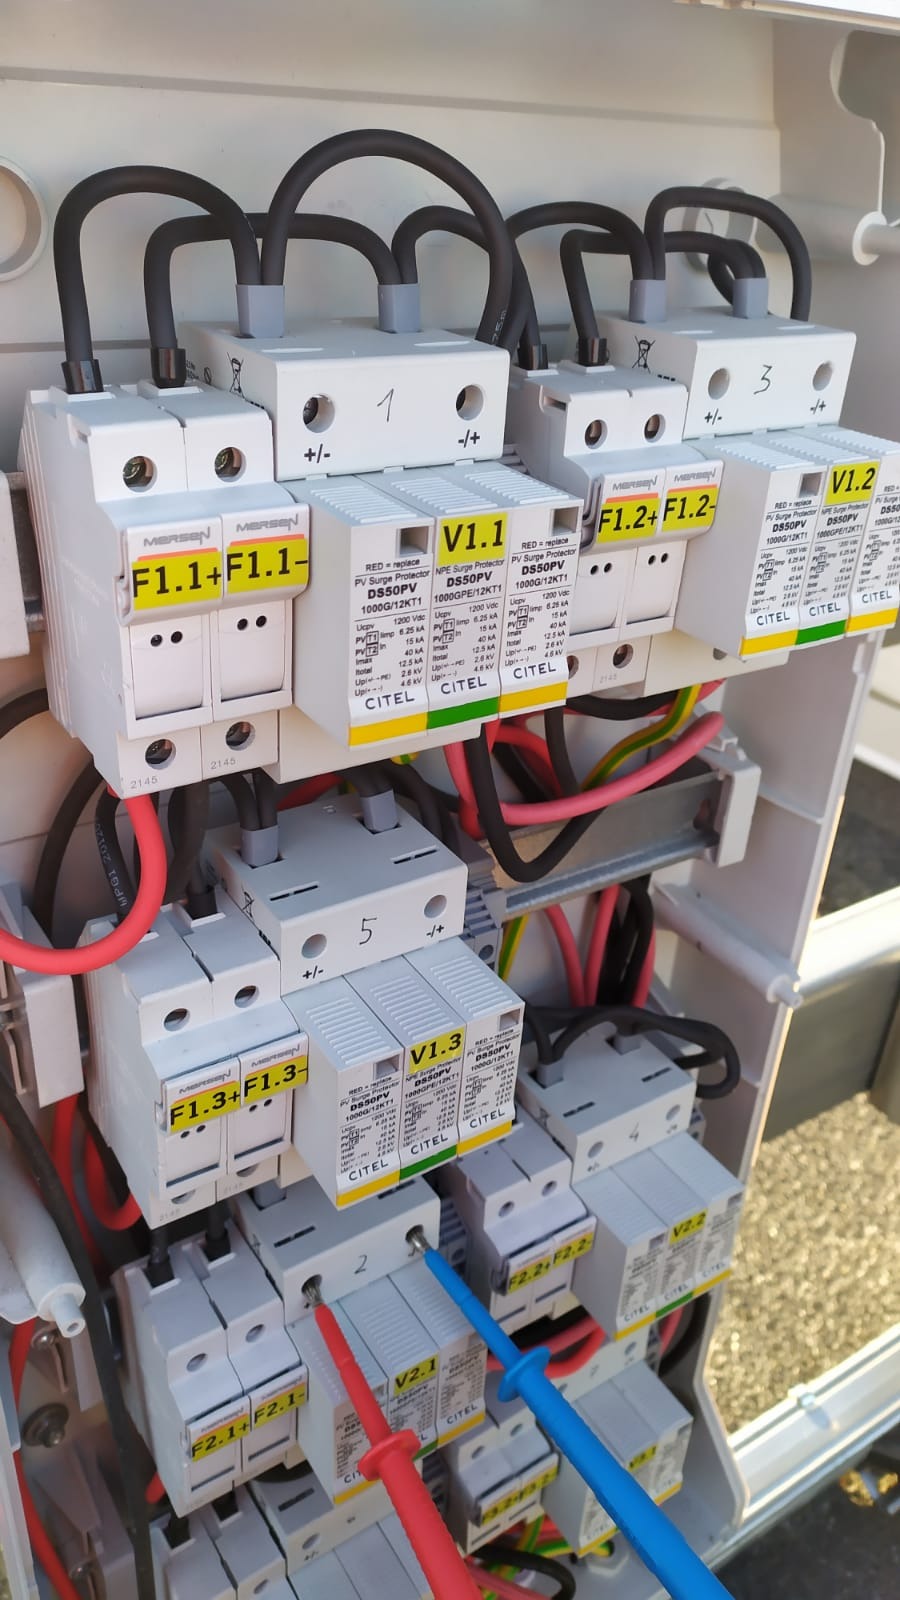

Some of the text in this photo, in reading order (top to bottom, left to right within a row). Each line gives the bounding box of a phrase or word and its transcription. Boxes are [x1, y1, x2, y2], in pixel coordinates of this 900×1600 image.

[753, 364, 773, 395] 3
[377, 388, 394, 423] 1
[832, 467, 876, 494] V1.2
[663, 494, 716, 522] F1.2-
[236, 513, 299, 533] MERSEN
[598, 505, 658, 533] F1.2+
[772, 520, 807, 533] DS50PV
[827, 513, 859, 526] DS50PV
[143, 526, 211, 547] MERSEN
[443, 519, 504, 553] V1.1
[521, 538, 569, 550] RED replace
[766, 532, 808, 545] 1000G/12KT1
[227, 547, 309, 582] F1.1-
[365, 558, 420, 572] RED replace
[511, 548, 577, 564] PV Surge Protector
[453, 563, 473, 574] Surge
[474, 559, 505, 570] Protector
[521, 560, 565, 576] DS50PV
[132, 561, 222, 598] F1.1+
[354, 569, 431, 587] PV Surge Protector
[446, 571, 493, 588] DS50PV
[515, 574, 568, 590] 1000G/12KT1
[367, 582, 418, 599] DS50PV
[434, 584, 502, 603] 1000GPE/12KT1
[861, 590, 892, 604] CITEL
[361, 597, 422, 614] 1000G/12KT1
[809, 602, 841, 617] CITEL
[756, 611, 791, 626] CITEL
[513, 661, 557, 680] CITEL
[440, 676, 488, 695] CITEL
[364, 691, 415, 710] CITEL
[210, 757, 236, 770] 2145
[130, 776, 159, 789] 2145
[359, 917, 377, 945] 5
[410, 1033, 462, 1065] V1.3
[475, 1043, 511, 1062] DS50PV
[244, 1064, 308, 1098] F1.3-
[414, 1066, 452, 1087] DS50PV
[170, 1091, 240, 1126] F1.3+
[350, 1091, 390, 1111] DS50PV
[469, 1108, 505, 1129] CITEL
[410, 1133, 448, 1155] CITEL
[348, 1159, 389, 1181] CITEL
[672, 1212, 706, 1238] V2.2
[354, 1254, 368, 1275] 2
[395, 1358, 437, 1389] V2.1
[254, 1393, 305, 1424] F2.1-
[446, 1404, 478, 1424] CITEL
[192, 1422, 249, 1458] F2.1+
